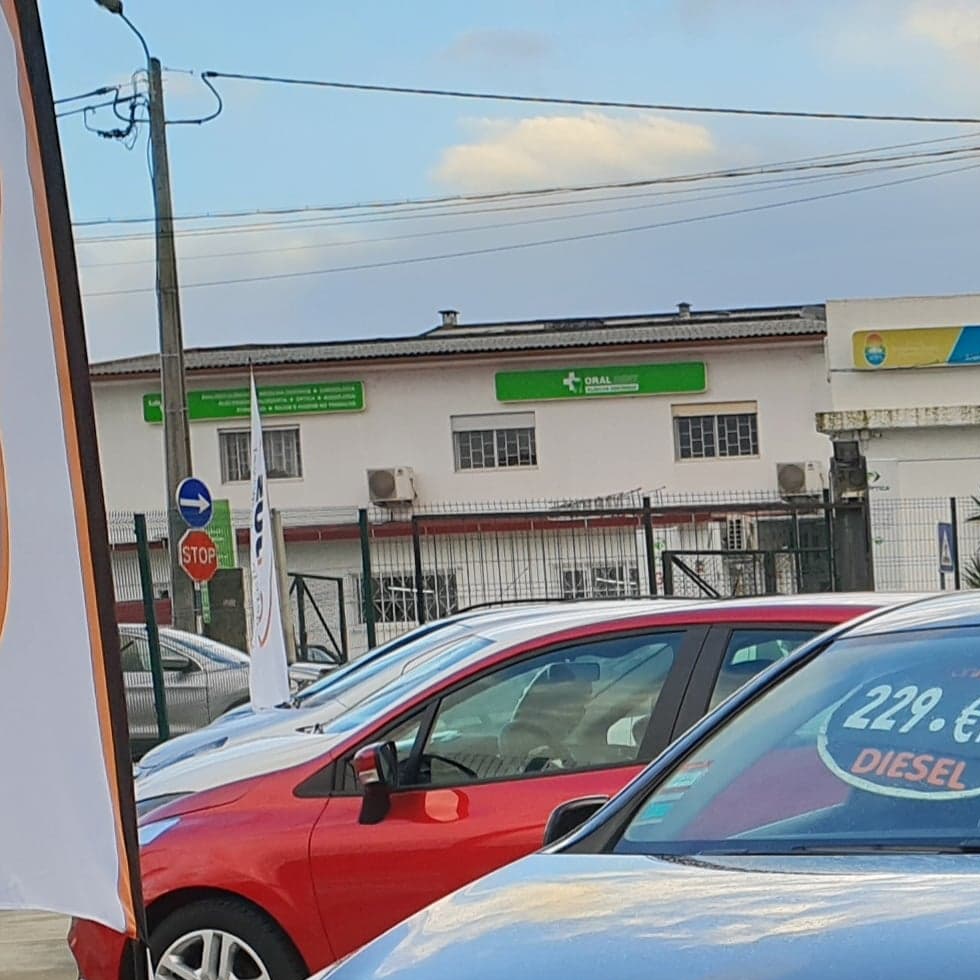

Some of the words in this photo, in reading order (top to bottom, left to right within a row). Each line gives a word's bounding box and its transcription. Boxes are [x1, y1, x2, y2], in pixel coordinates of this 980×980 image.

[585, 376, 612, 385] ORAL
[182, 546, 216, 565] STOP
[851, 748, 967, 790] DIESEL
